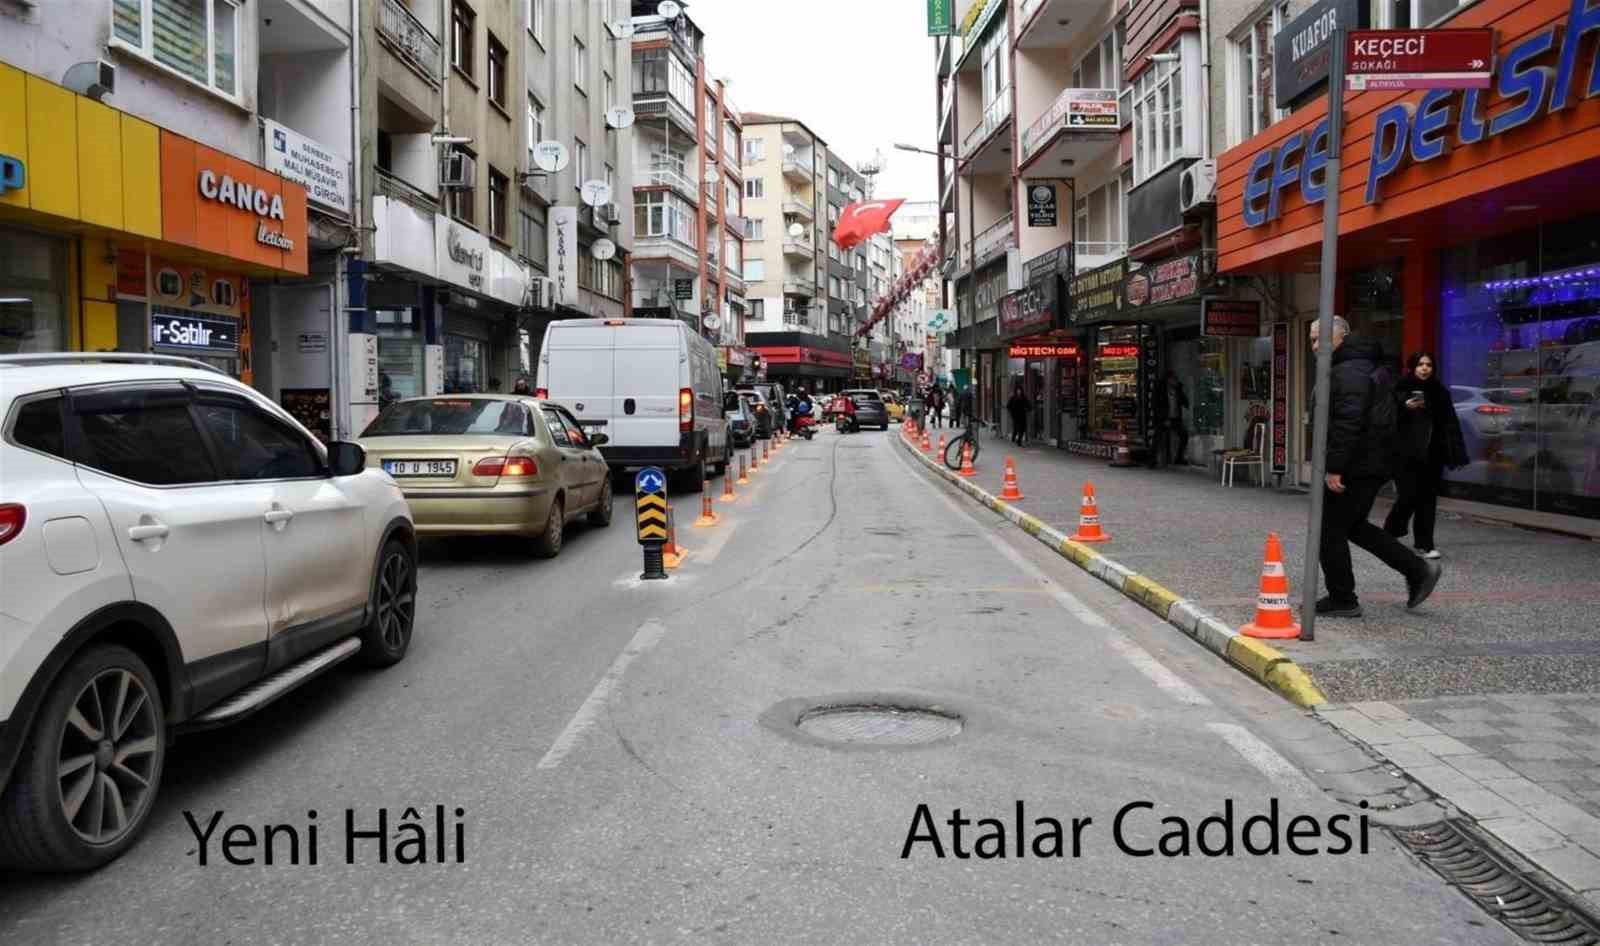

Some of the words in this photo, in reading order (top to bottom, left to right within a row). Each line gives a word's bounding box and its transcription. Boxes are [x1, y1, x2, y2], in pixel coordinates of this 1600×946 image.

[1354, 35, 1425, 58] KEÇECİ
[1352, 61, 1397, 71] SOKAĞI
[199, 168, 285, 220] CANCA
[394, 462, 405, 473] 10
